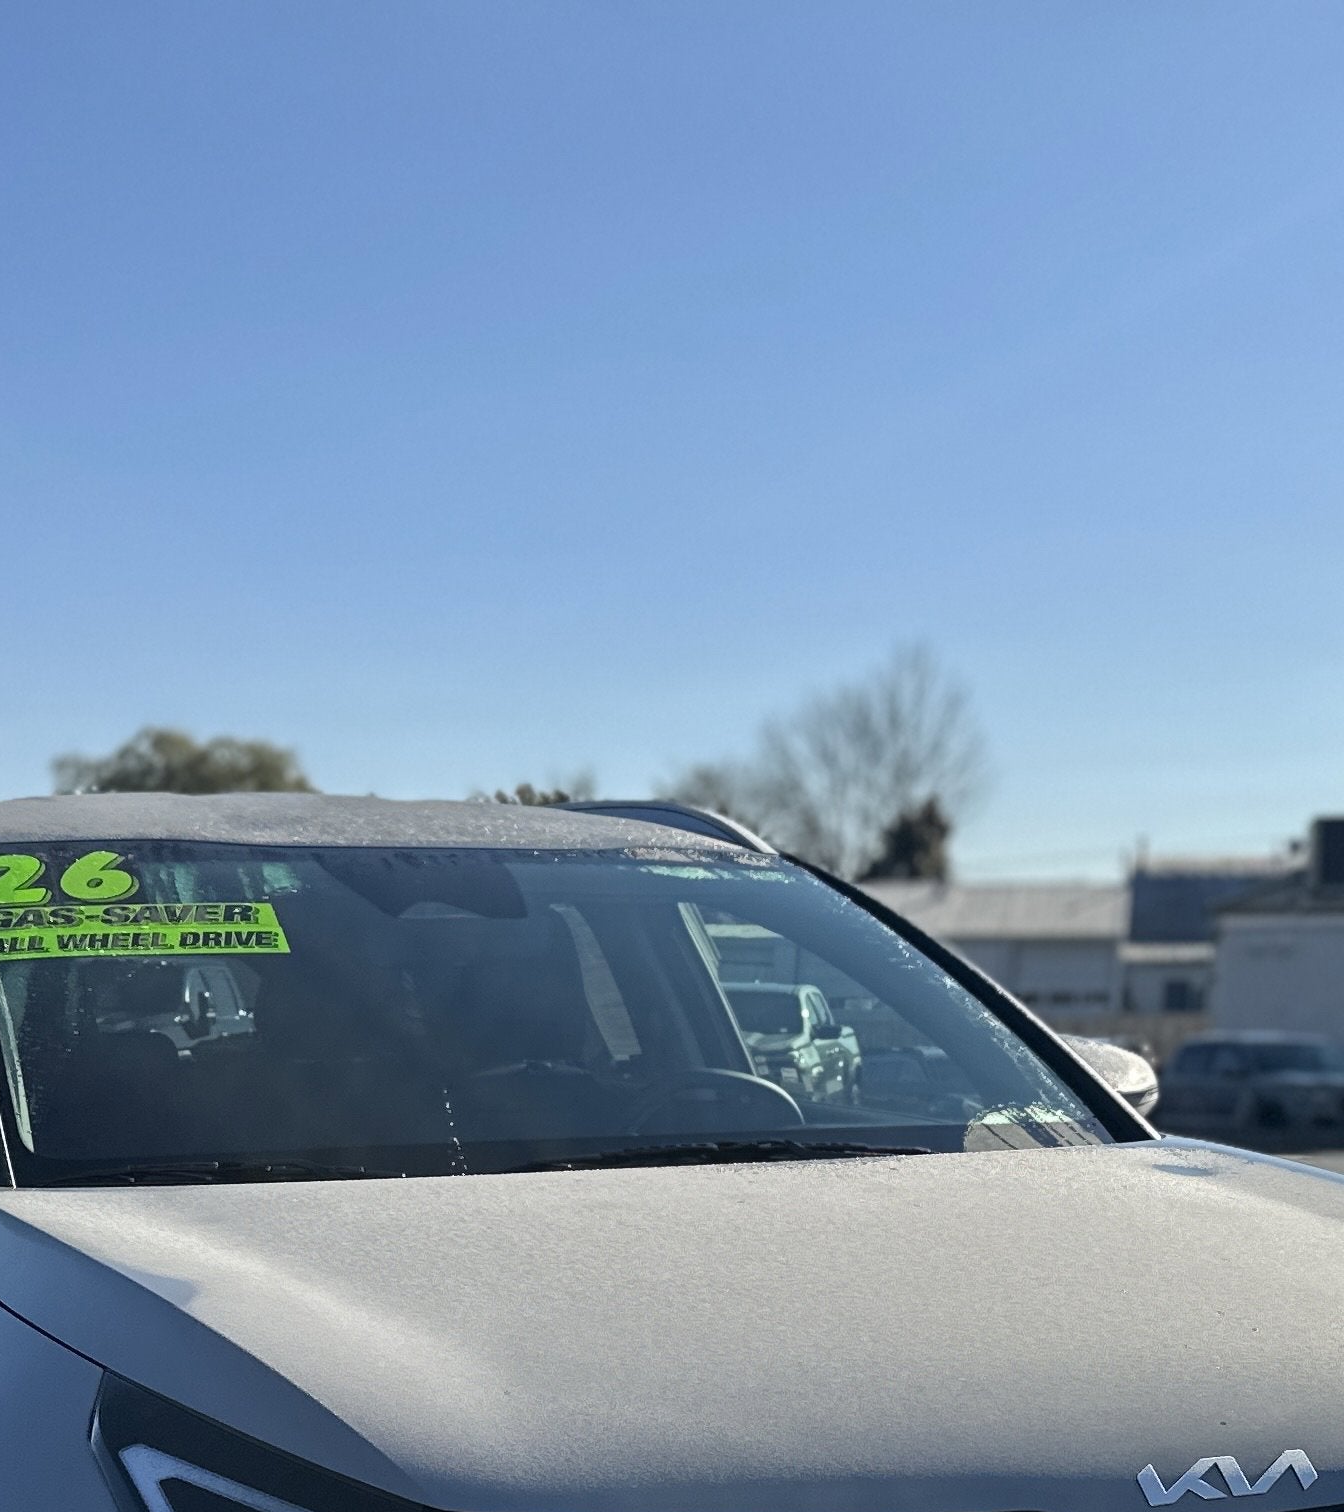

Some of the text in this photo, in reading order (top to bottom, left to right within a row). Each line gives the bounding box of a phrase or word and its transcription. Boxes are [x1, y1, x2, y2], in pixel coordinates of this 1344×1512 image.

[56, 931, 175, 952] WHEEL
[178, 930, 280, 950] DRIVE
[1137, 1449, 1319, 1507] KIA
